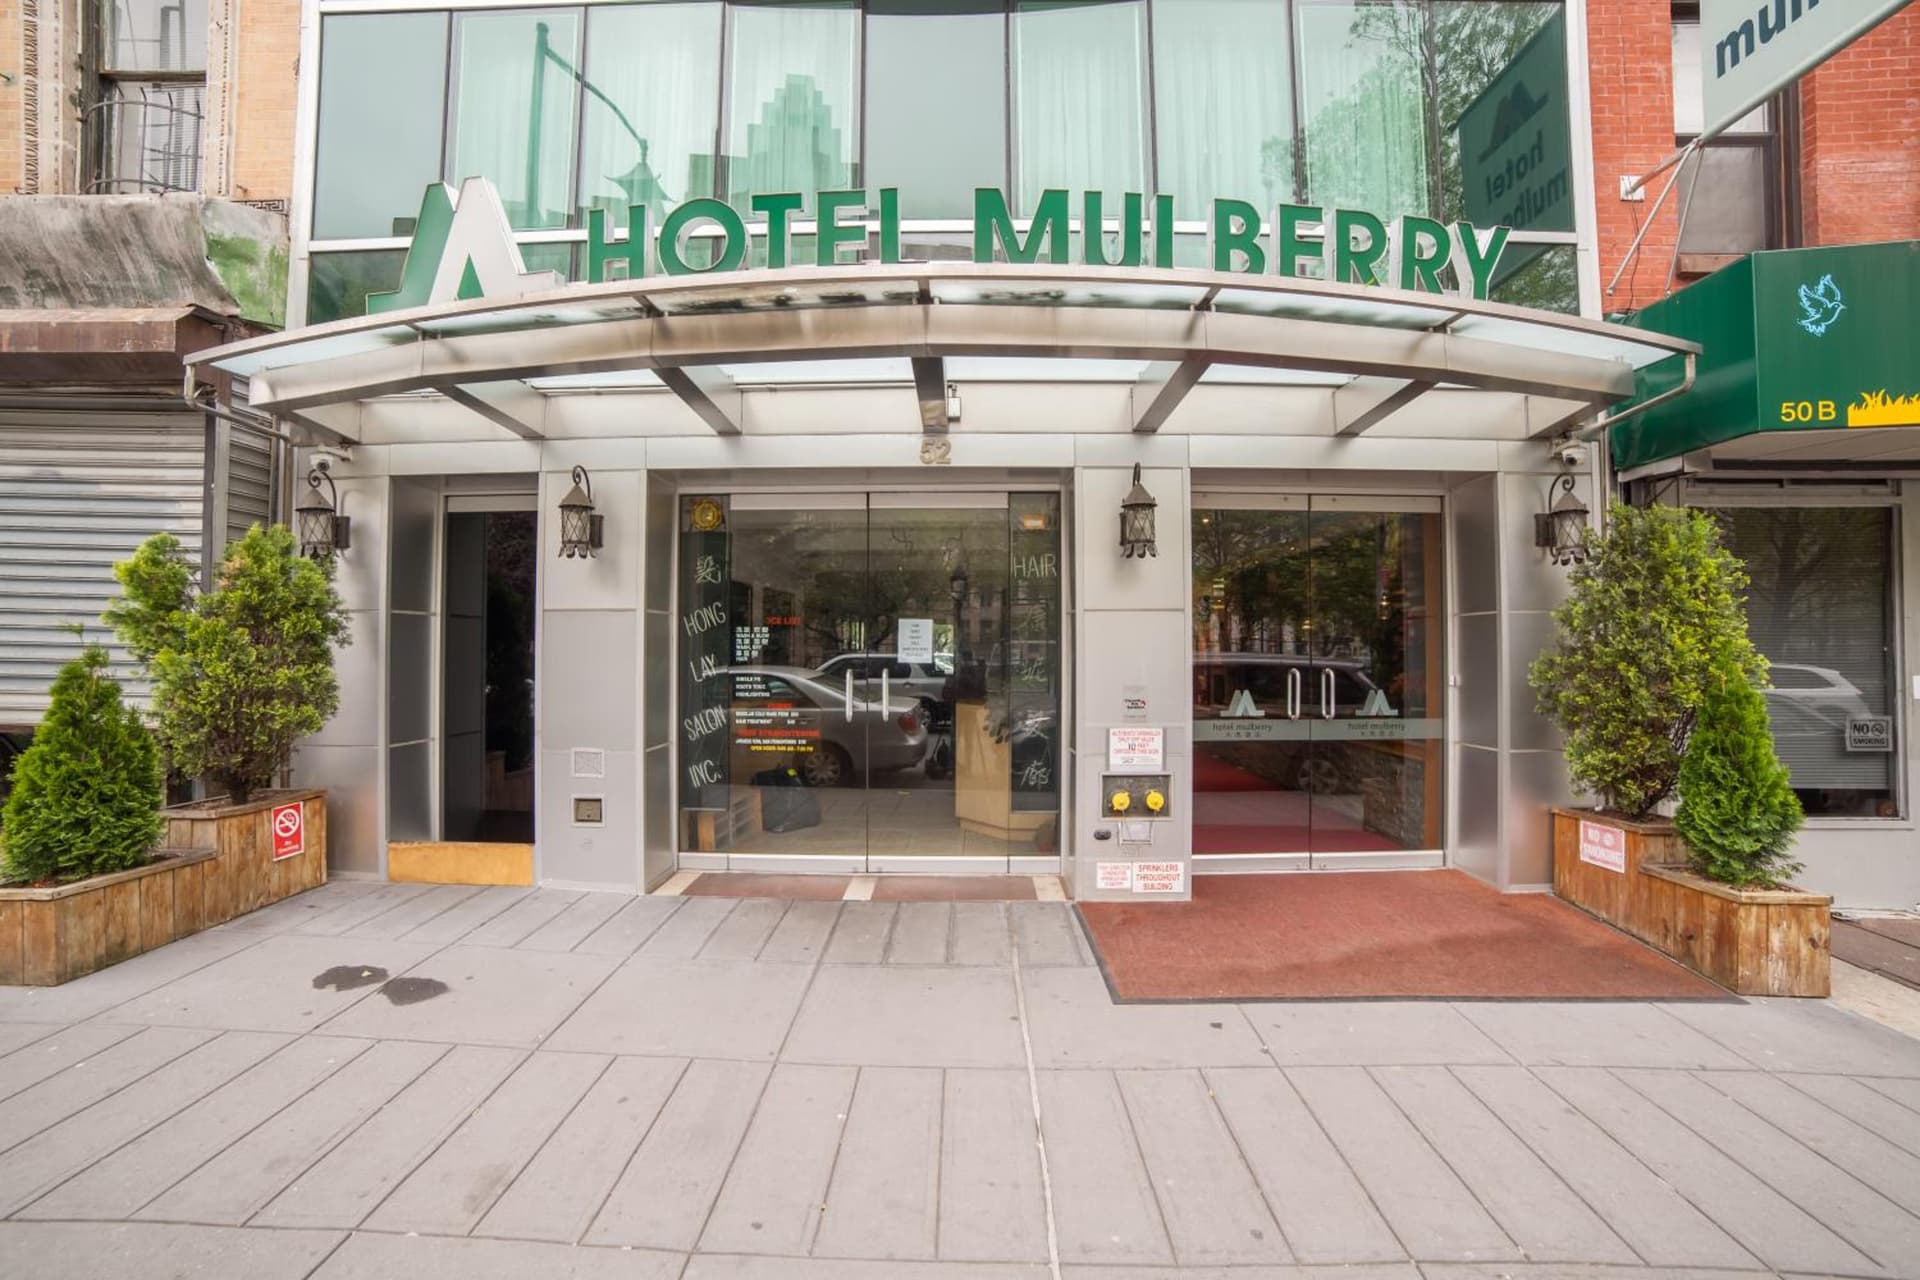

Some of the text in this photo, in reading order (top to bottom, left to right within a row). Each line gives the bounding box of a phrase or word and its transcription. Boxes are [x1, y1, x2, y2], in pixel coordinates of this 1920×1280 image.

[587, 186, 1513, 301] HOTEL MULBERRY
[1781, 400, 1836, 422] 50 B
[920, 439, 951, 465] 52
[1012, 553, 1057, 578] HAIR
[683, 601, 727, 637] HONG
[689, 653, 717, 682] LAY
[684, 704, 728, 741] SALON
[1852, 723, 1870, 735] NO
[688, 759, 722, 788] INC.
